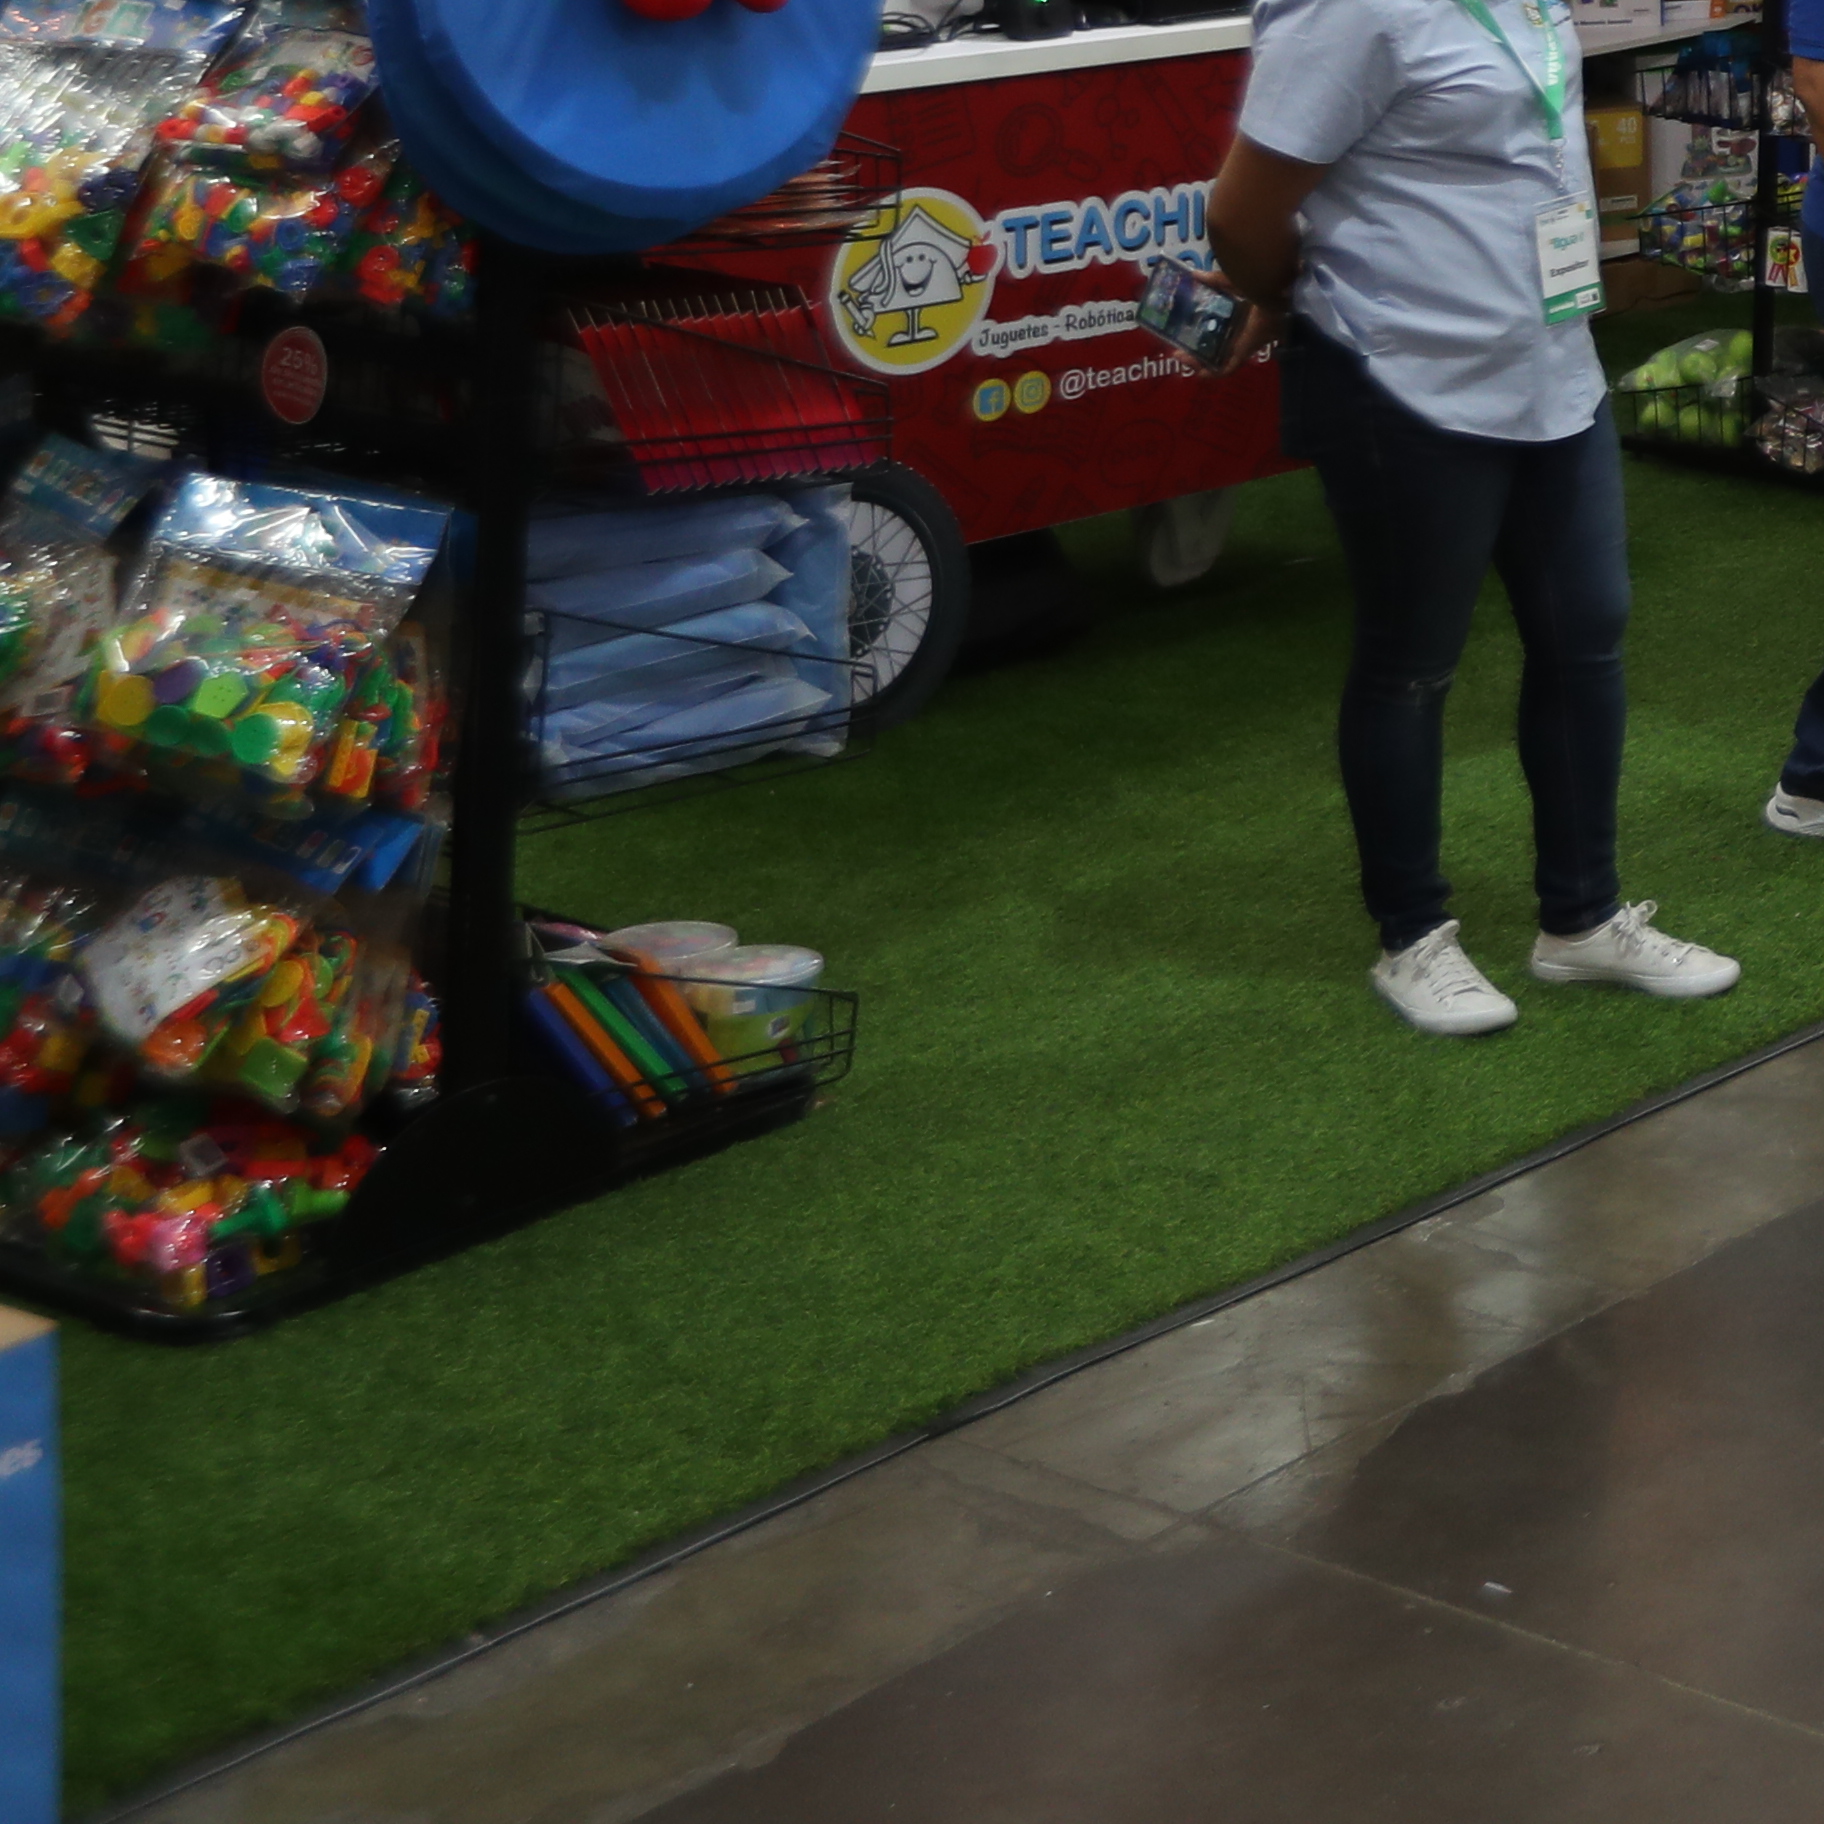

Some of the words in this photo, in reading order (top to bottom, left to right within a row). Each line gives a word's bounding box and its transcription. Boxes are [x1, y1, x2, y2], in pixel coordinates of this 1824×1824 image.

[1616, 117, 1637, 134] 40
[1003, 189, 1205, 269] TEACHI
[978, 326, 1048, 350] Juguetes
[1064, 309, 1135, 333] Robótica
